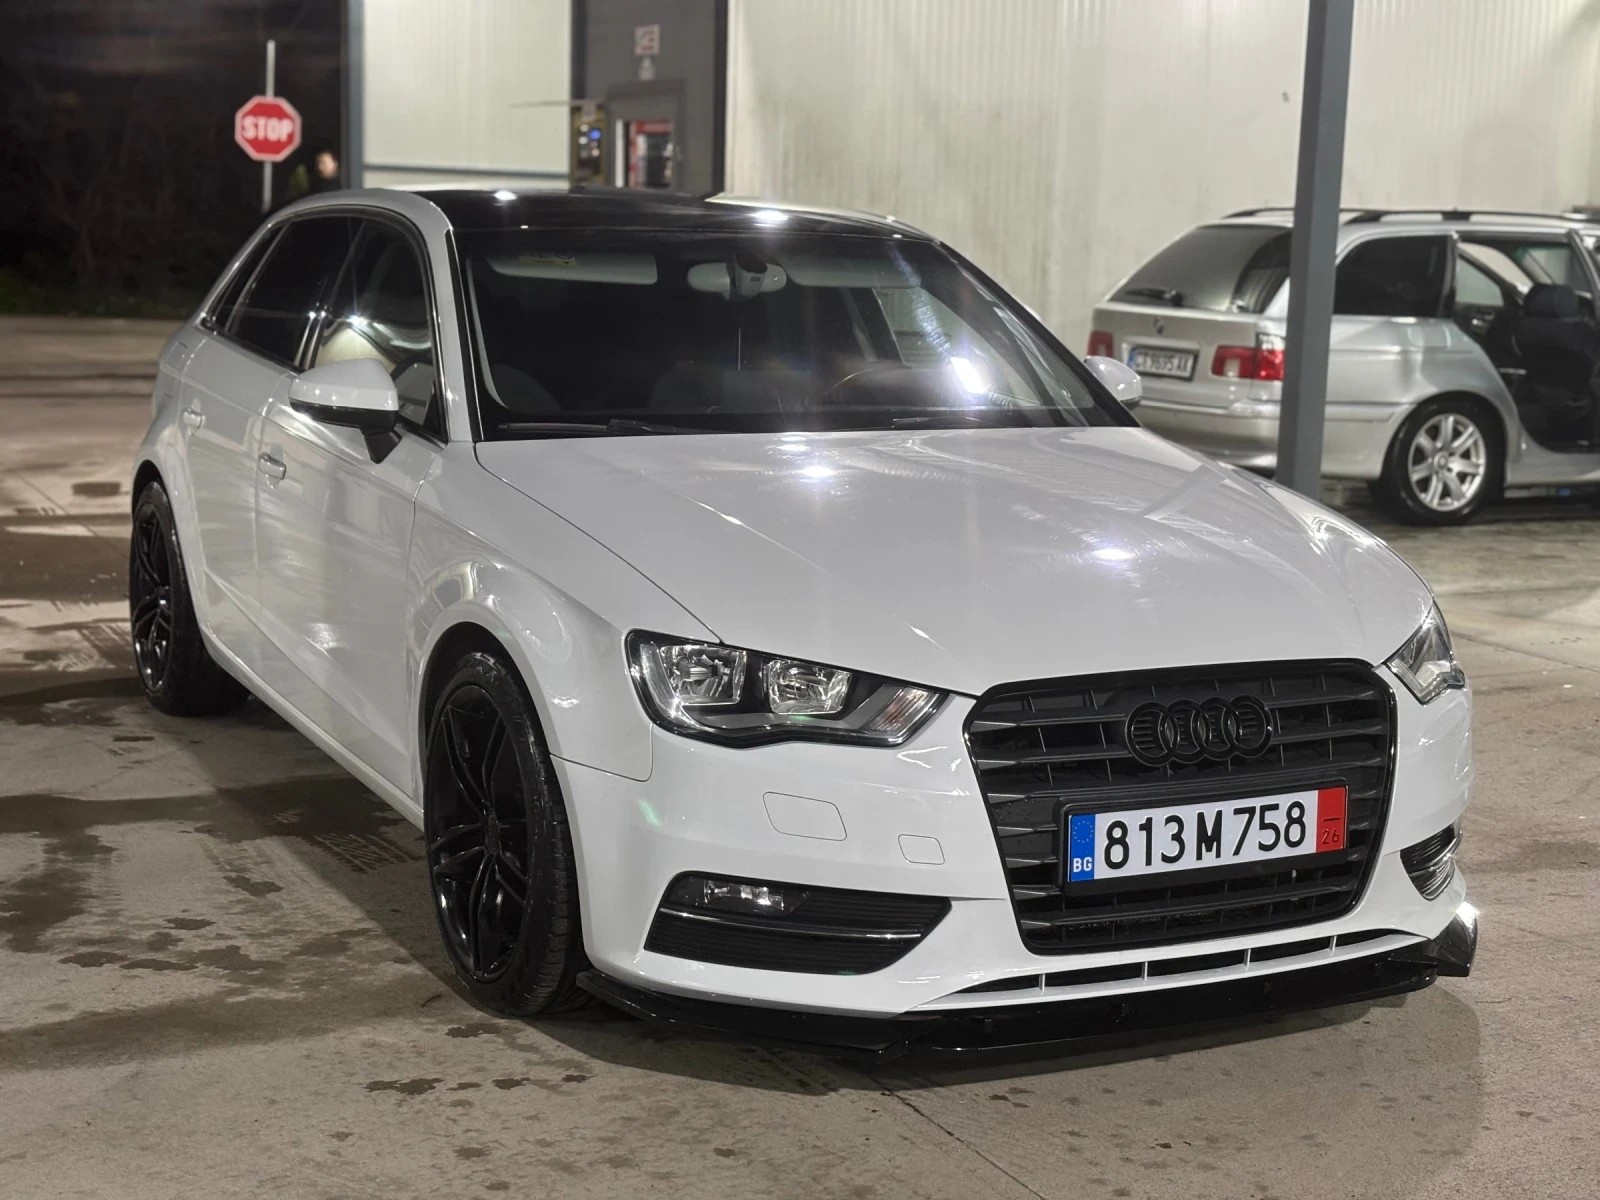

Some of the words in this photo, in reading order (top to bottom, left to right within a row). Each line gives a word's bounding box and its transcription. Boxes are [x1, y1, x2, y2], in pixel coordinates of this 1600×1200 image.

[241, 115, 294, 142] STOP
[1104, 800, 1307, 870] 813M758
[1321, 828, 1340, 845] 26
[1072, 856, 1093, 873] BG
